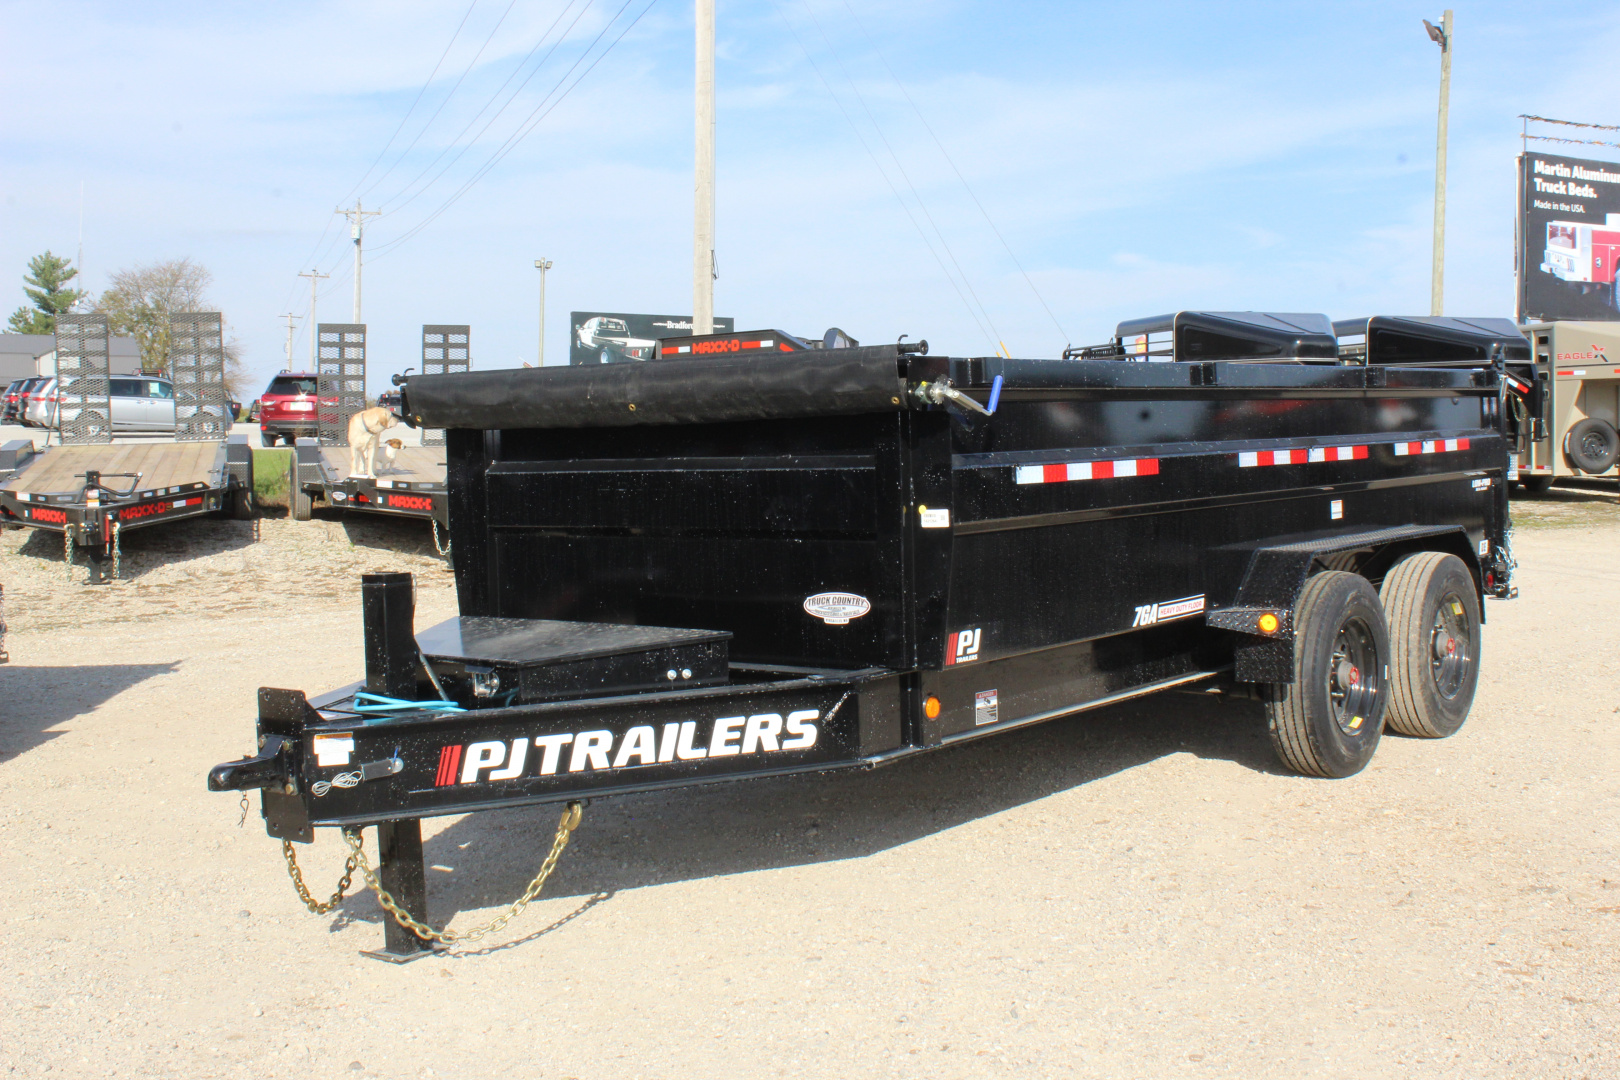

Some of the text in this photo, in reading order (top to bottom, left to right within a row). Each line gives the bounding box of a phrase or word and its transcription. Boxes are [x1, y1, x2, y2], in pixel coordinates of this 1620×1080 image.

[1534, 160, 1571, 178] Martin
[1534, 178, 1598, 198] Truck Beds.
[1534, 200, 1586, 213] Made in the USA.
[692, 339, 740, 355] MAXX-D
[1557, 352, 1593, 360] EAGLE
[119, 501, 166, 520] MAXX-D
[807, 596, 865, 606] TRUCK COUNTRY
[1132, 600, 1203, 627] 7GA HEAVY DUTY FLOOR
[957, 628, 981, 657] PJ
[956, 654, 978, 663] TRAILERS
[460, 709, 820, 784] PJ TRAILERS
